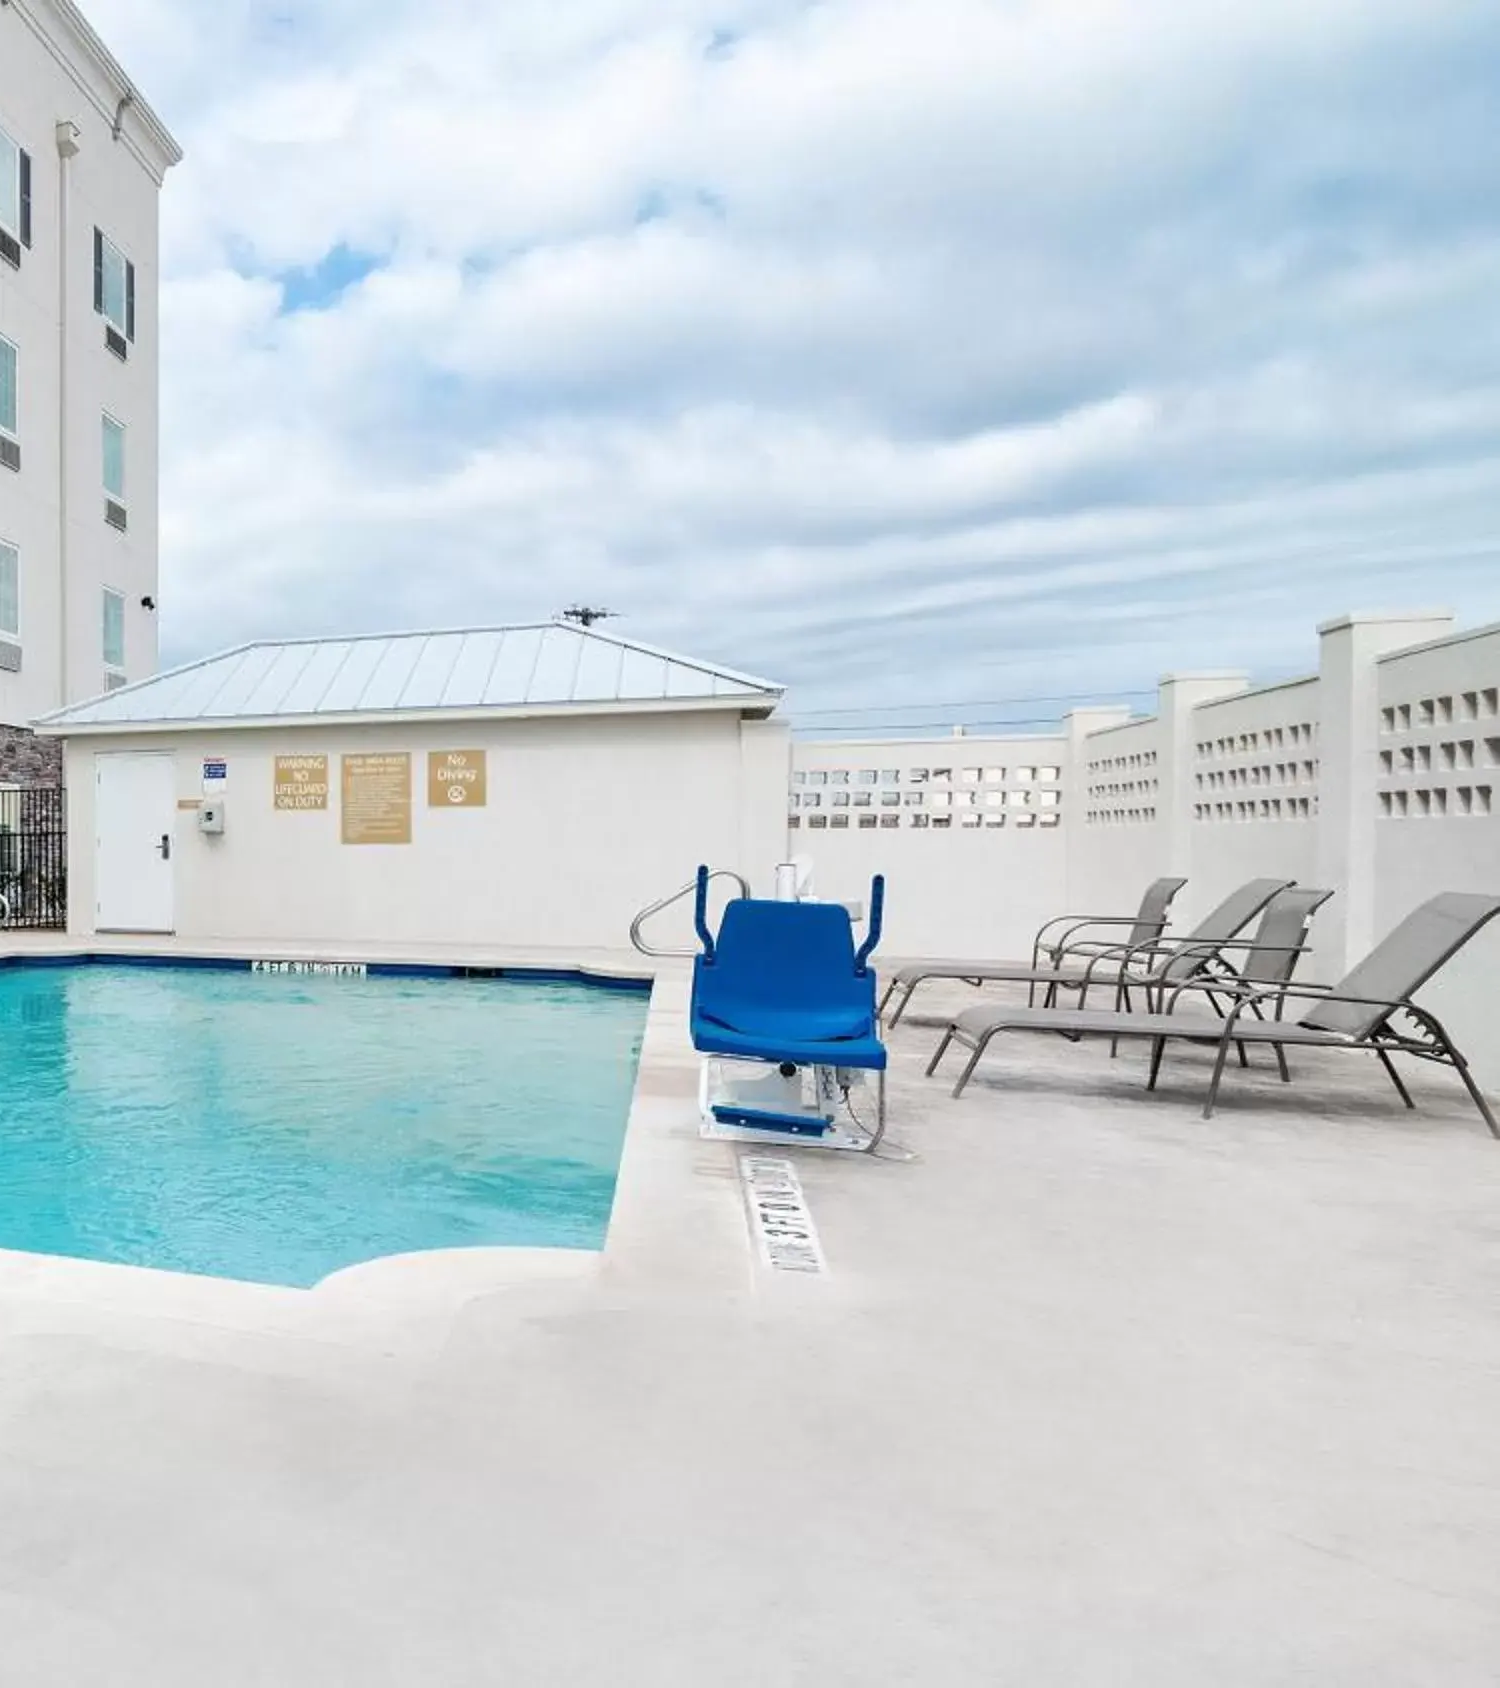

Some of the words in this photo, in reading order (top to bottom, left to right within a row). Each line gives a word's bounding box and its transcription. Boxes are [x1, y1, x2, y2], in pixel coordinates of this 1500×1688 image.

[278, 758, 325, 769] WARNING
[447, 754, 467, 766] No
[293, 770, 309, 781] NO
[437, 766, 478, 783] Diving
[275, 783, 328, 795] LIFEGUARD
[277, 796, 293, 808] ON
[295, 795, 324, 807] DUTY
